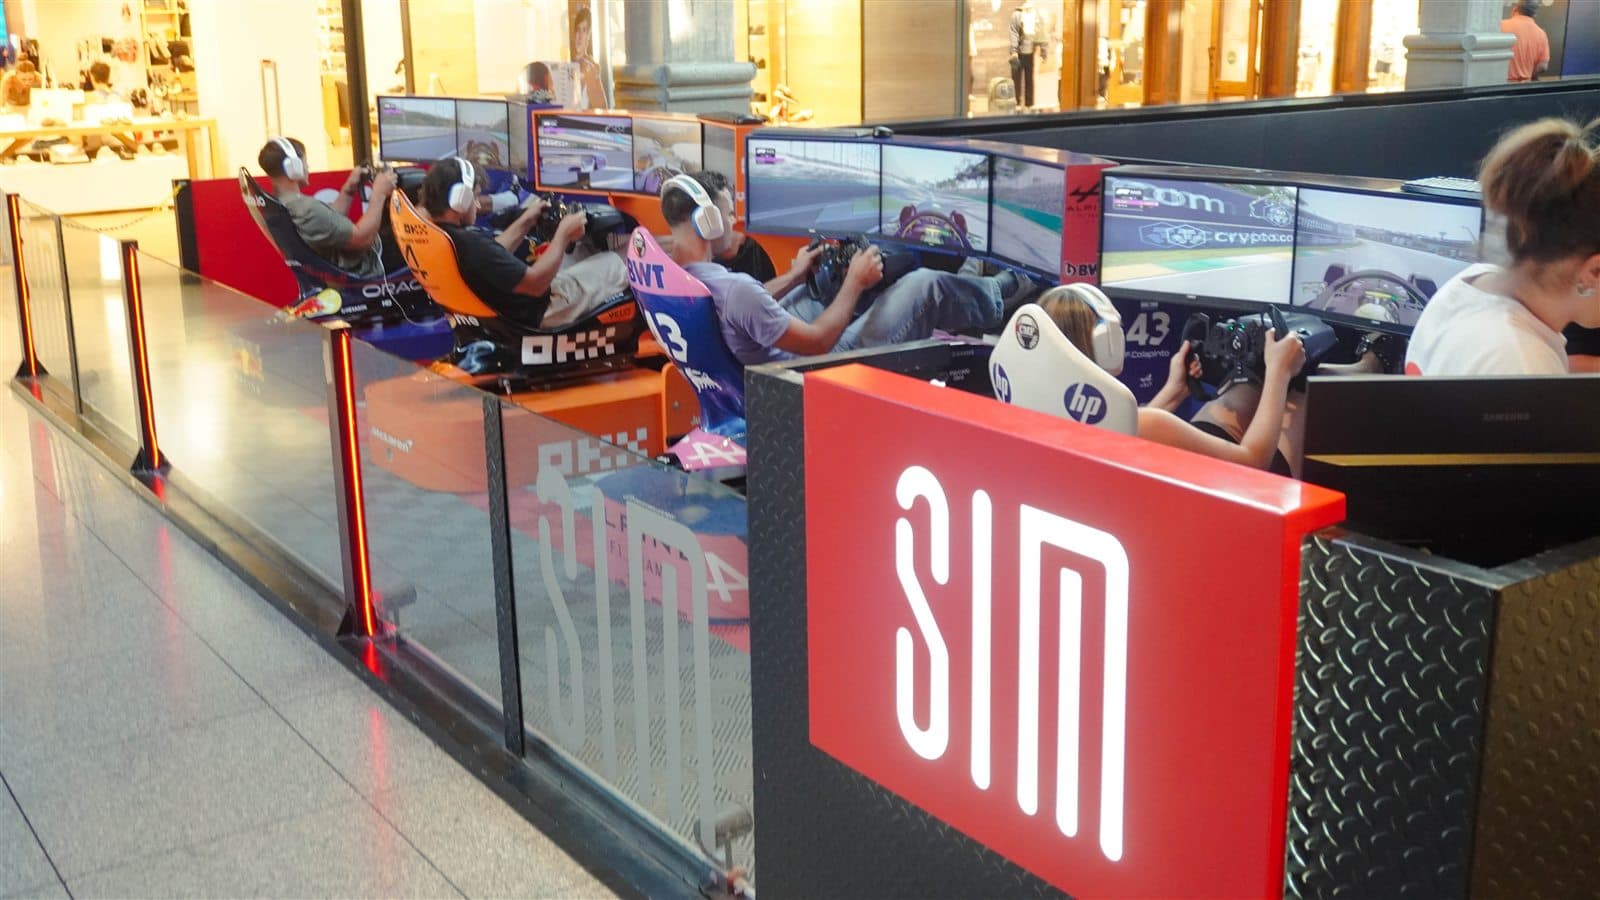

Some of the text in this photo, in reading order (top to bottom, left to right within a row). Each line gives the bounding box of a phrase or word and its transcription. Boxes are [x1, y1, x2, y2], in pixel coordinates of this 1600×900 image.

[1214, 231, 1294, 245] crypto.co
[362, 281, 423, 298] ORAC
[627, 258, 665, 290] BWT
[521, 326, 616, 366] OKX
[1126, 311, 1170, 346] 43
[1068, 383, 1101, 424] hp
[537, 427, 648, 475] OKX
[895, 465, 1130, 862] SIM
